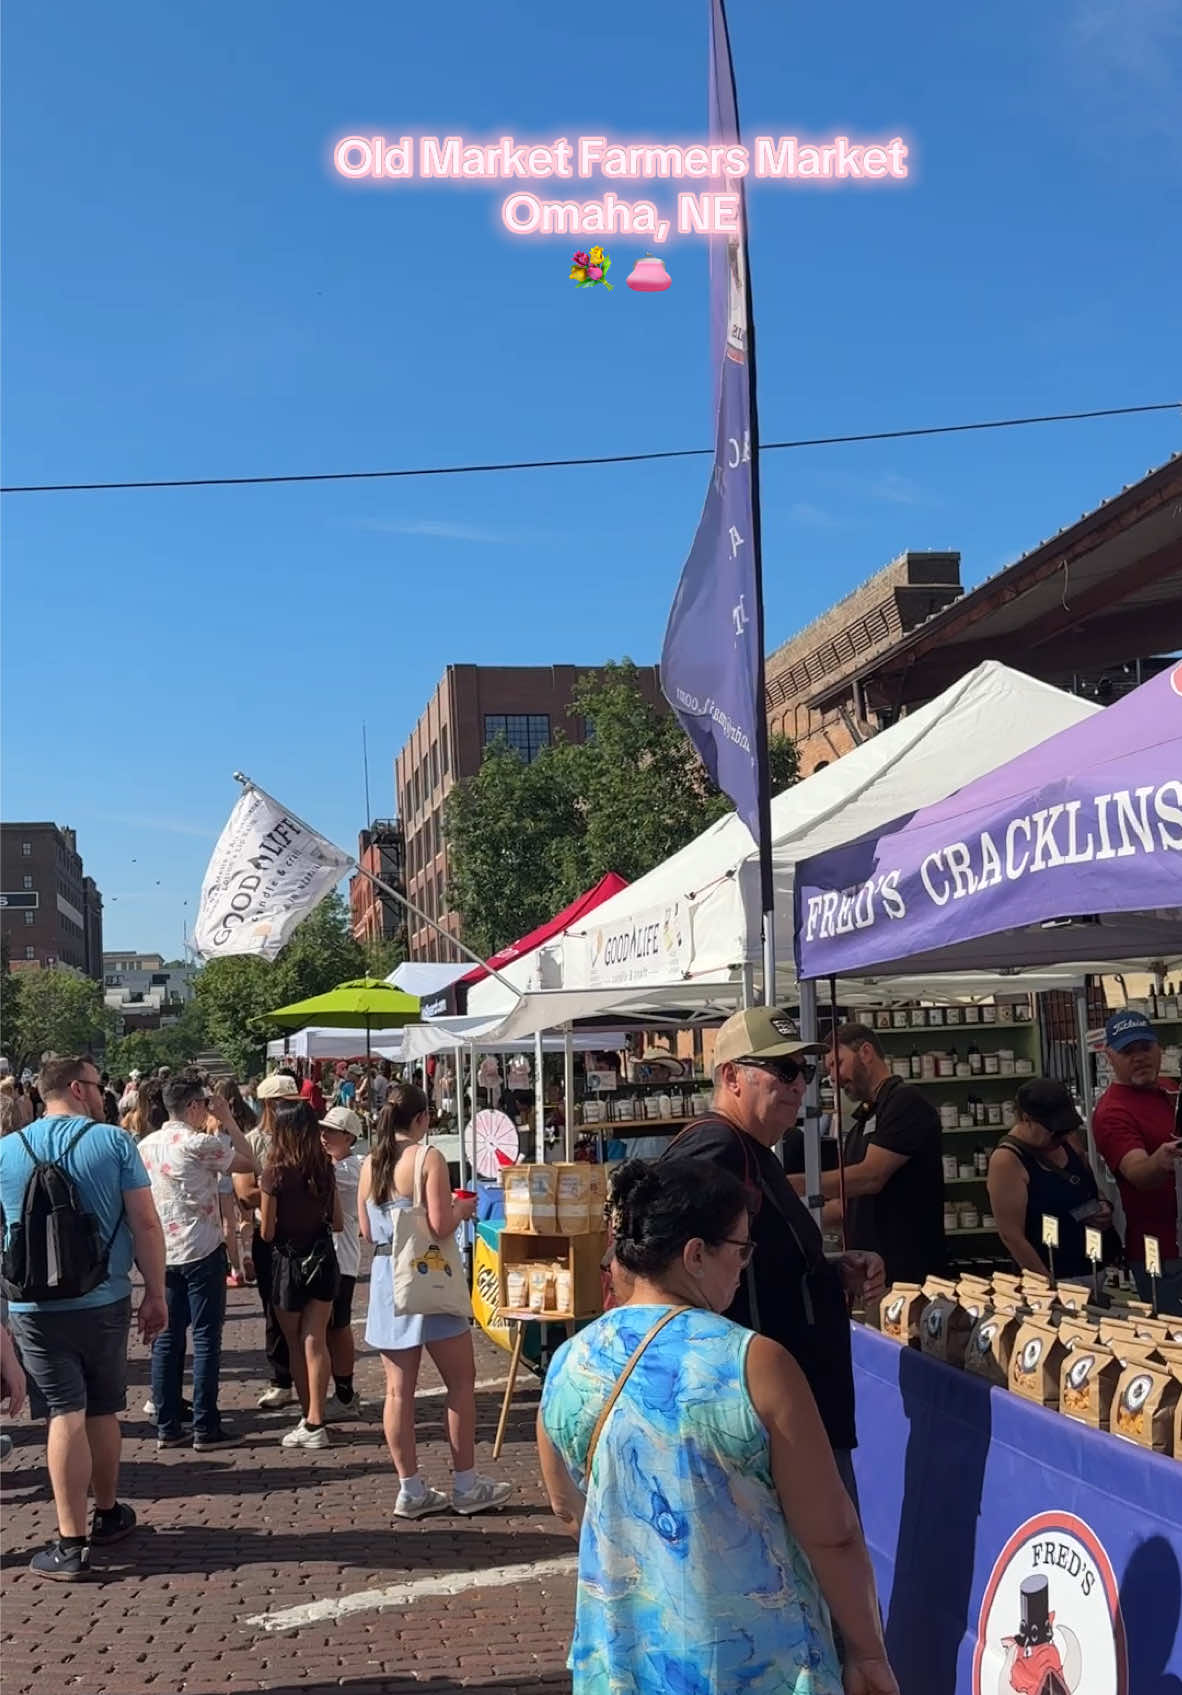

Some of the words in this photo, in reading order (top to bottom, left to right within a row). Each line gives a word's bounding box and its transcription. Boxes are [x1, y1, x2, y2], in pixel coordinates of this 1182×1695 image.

[805, 868, 907, 942] FRED'S
[920, 780, 1182, 906] CRACKLINS
[604, 932, 630, 967] GOOD
[637, 922, 660, 958] LIFE
[1031, 1541, 1096, 1596] FRED'S
